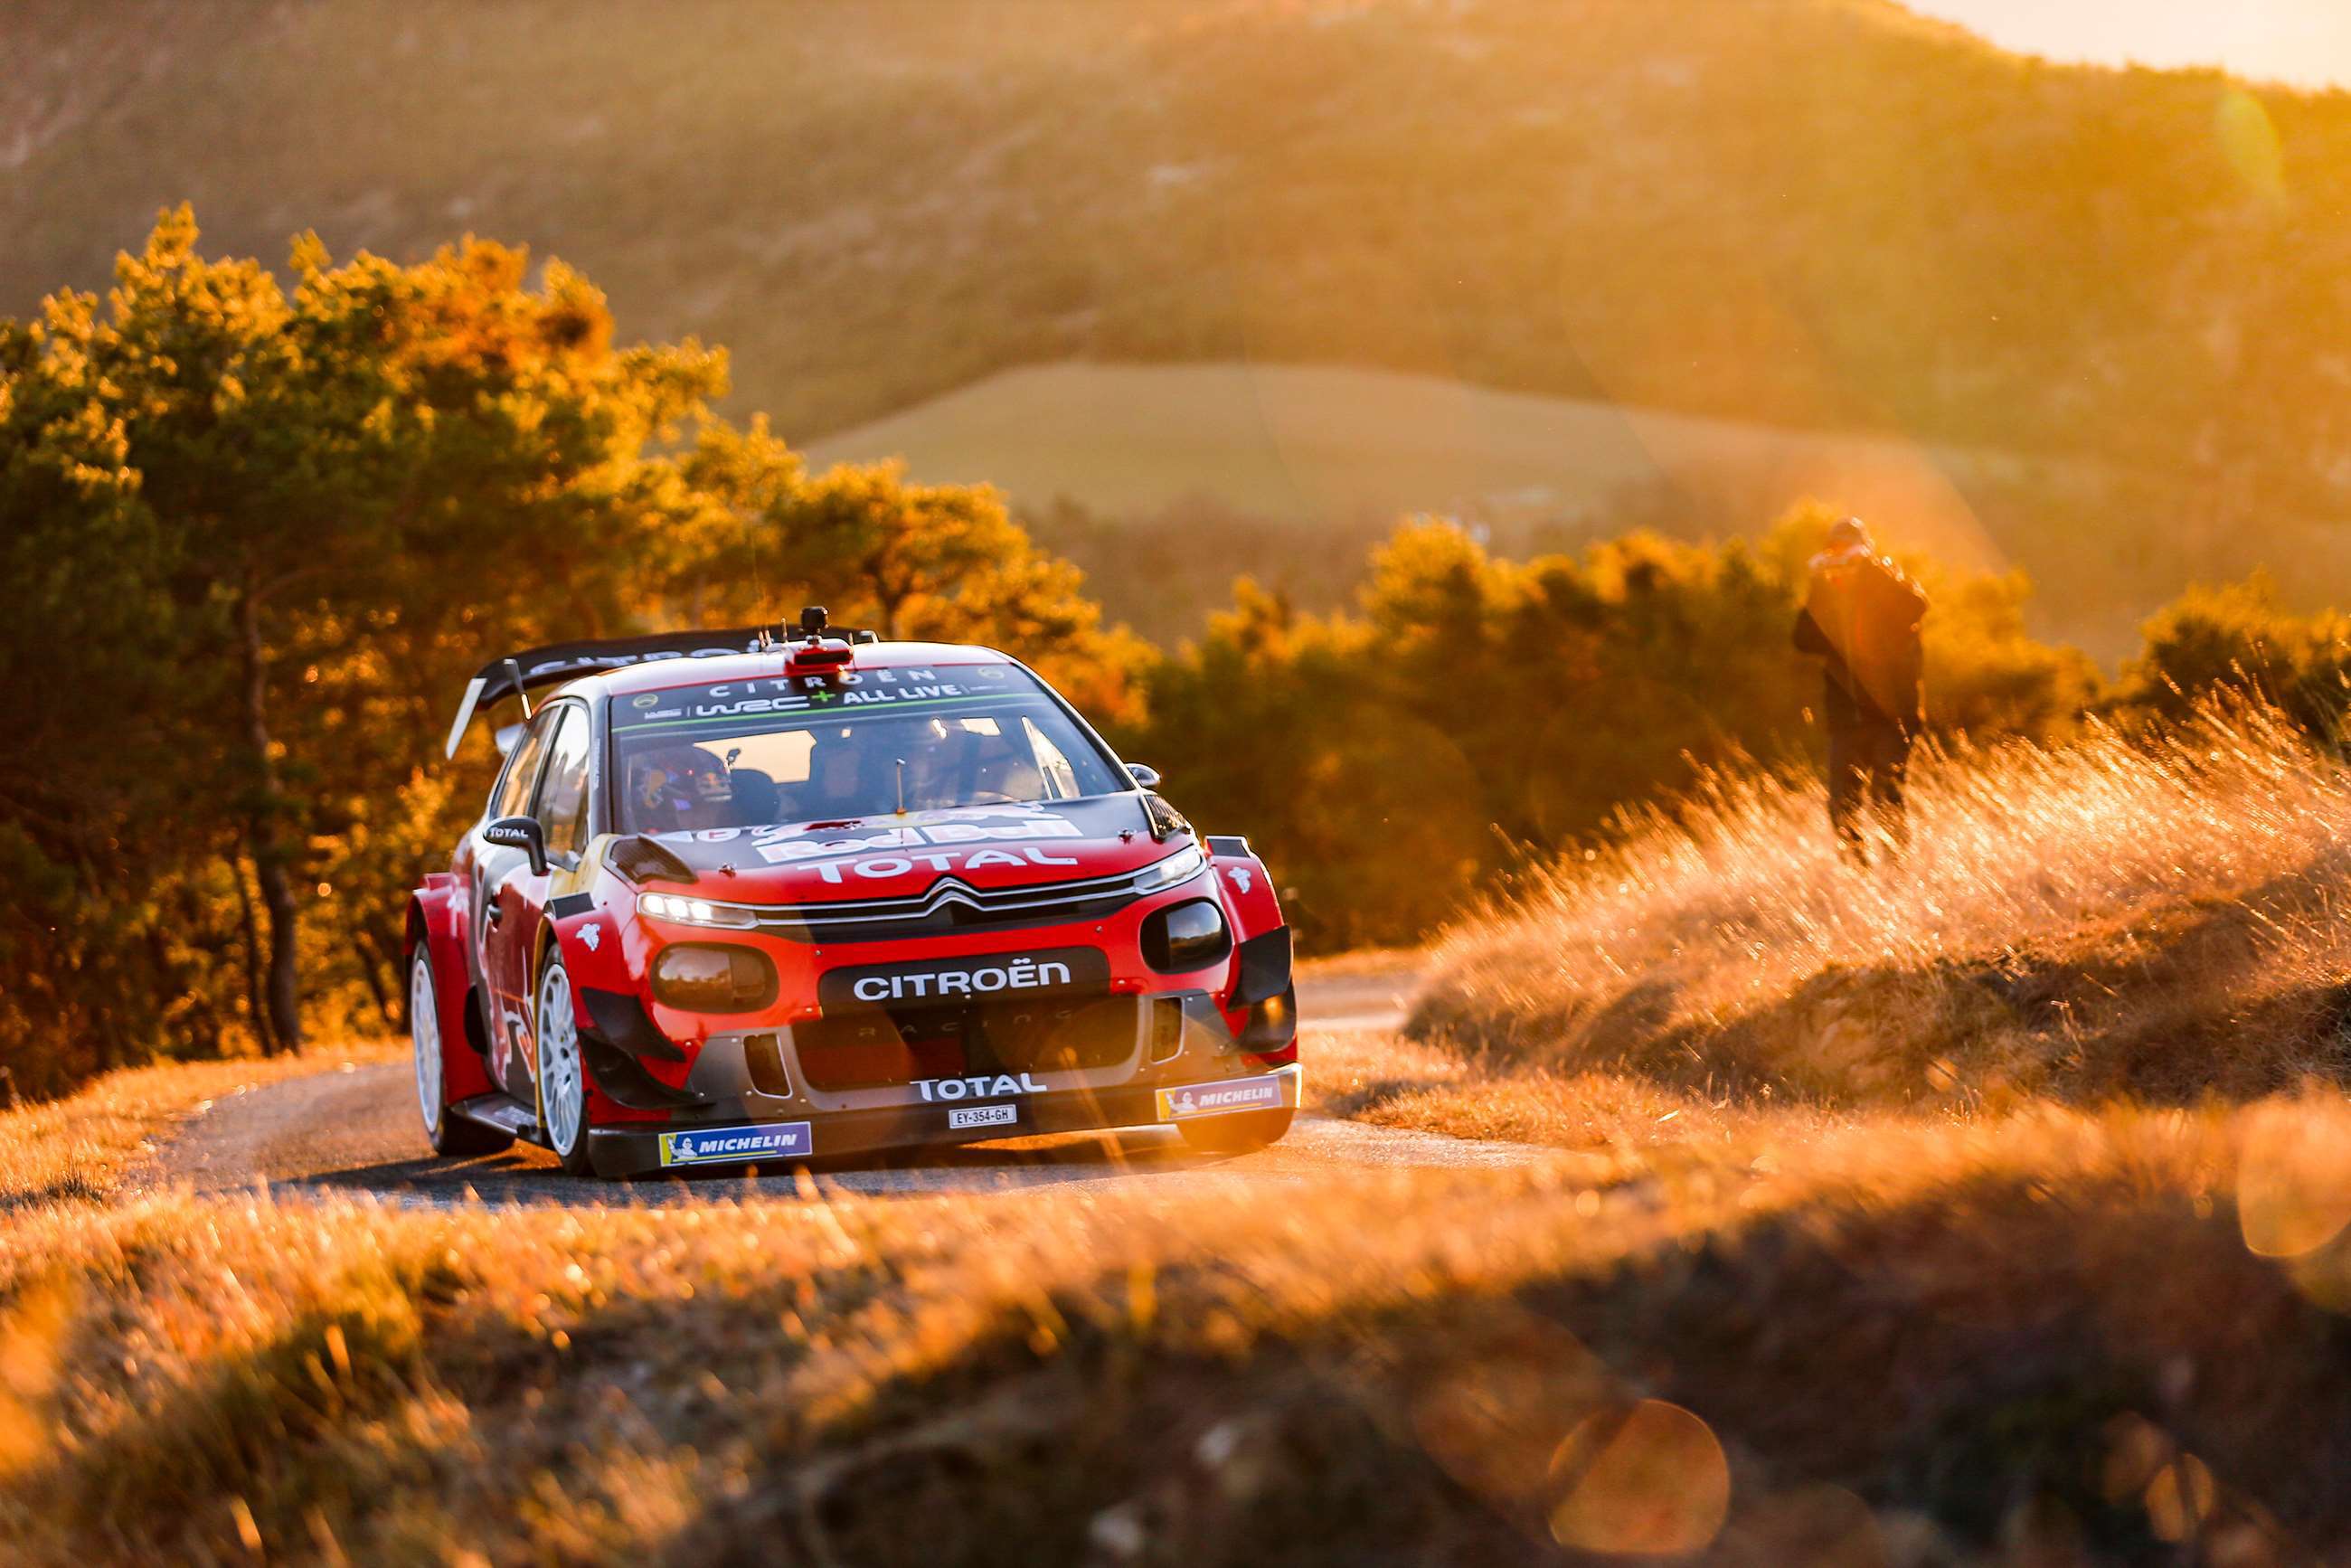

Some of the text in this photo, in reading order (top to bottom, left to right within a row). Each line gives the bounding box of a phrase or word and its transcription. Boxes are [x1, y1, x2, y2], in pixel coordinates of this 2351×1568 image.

[843, 689, 896, 705] ALL
[898, 684, 962, 701] LIVE
[489, 827, 529, 838] TOTAL
[797, 847, 1079, 883] TOTAL
[910, 1072, 1048, 1101] TOTAL
[1199, 1087, 1273, 1107] MICHELIN
[957, 1109, 1009, 1124] EY-354-GH
[699, 1133, 798, 1154] MICHELIN
